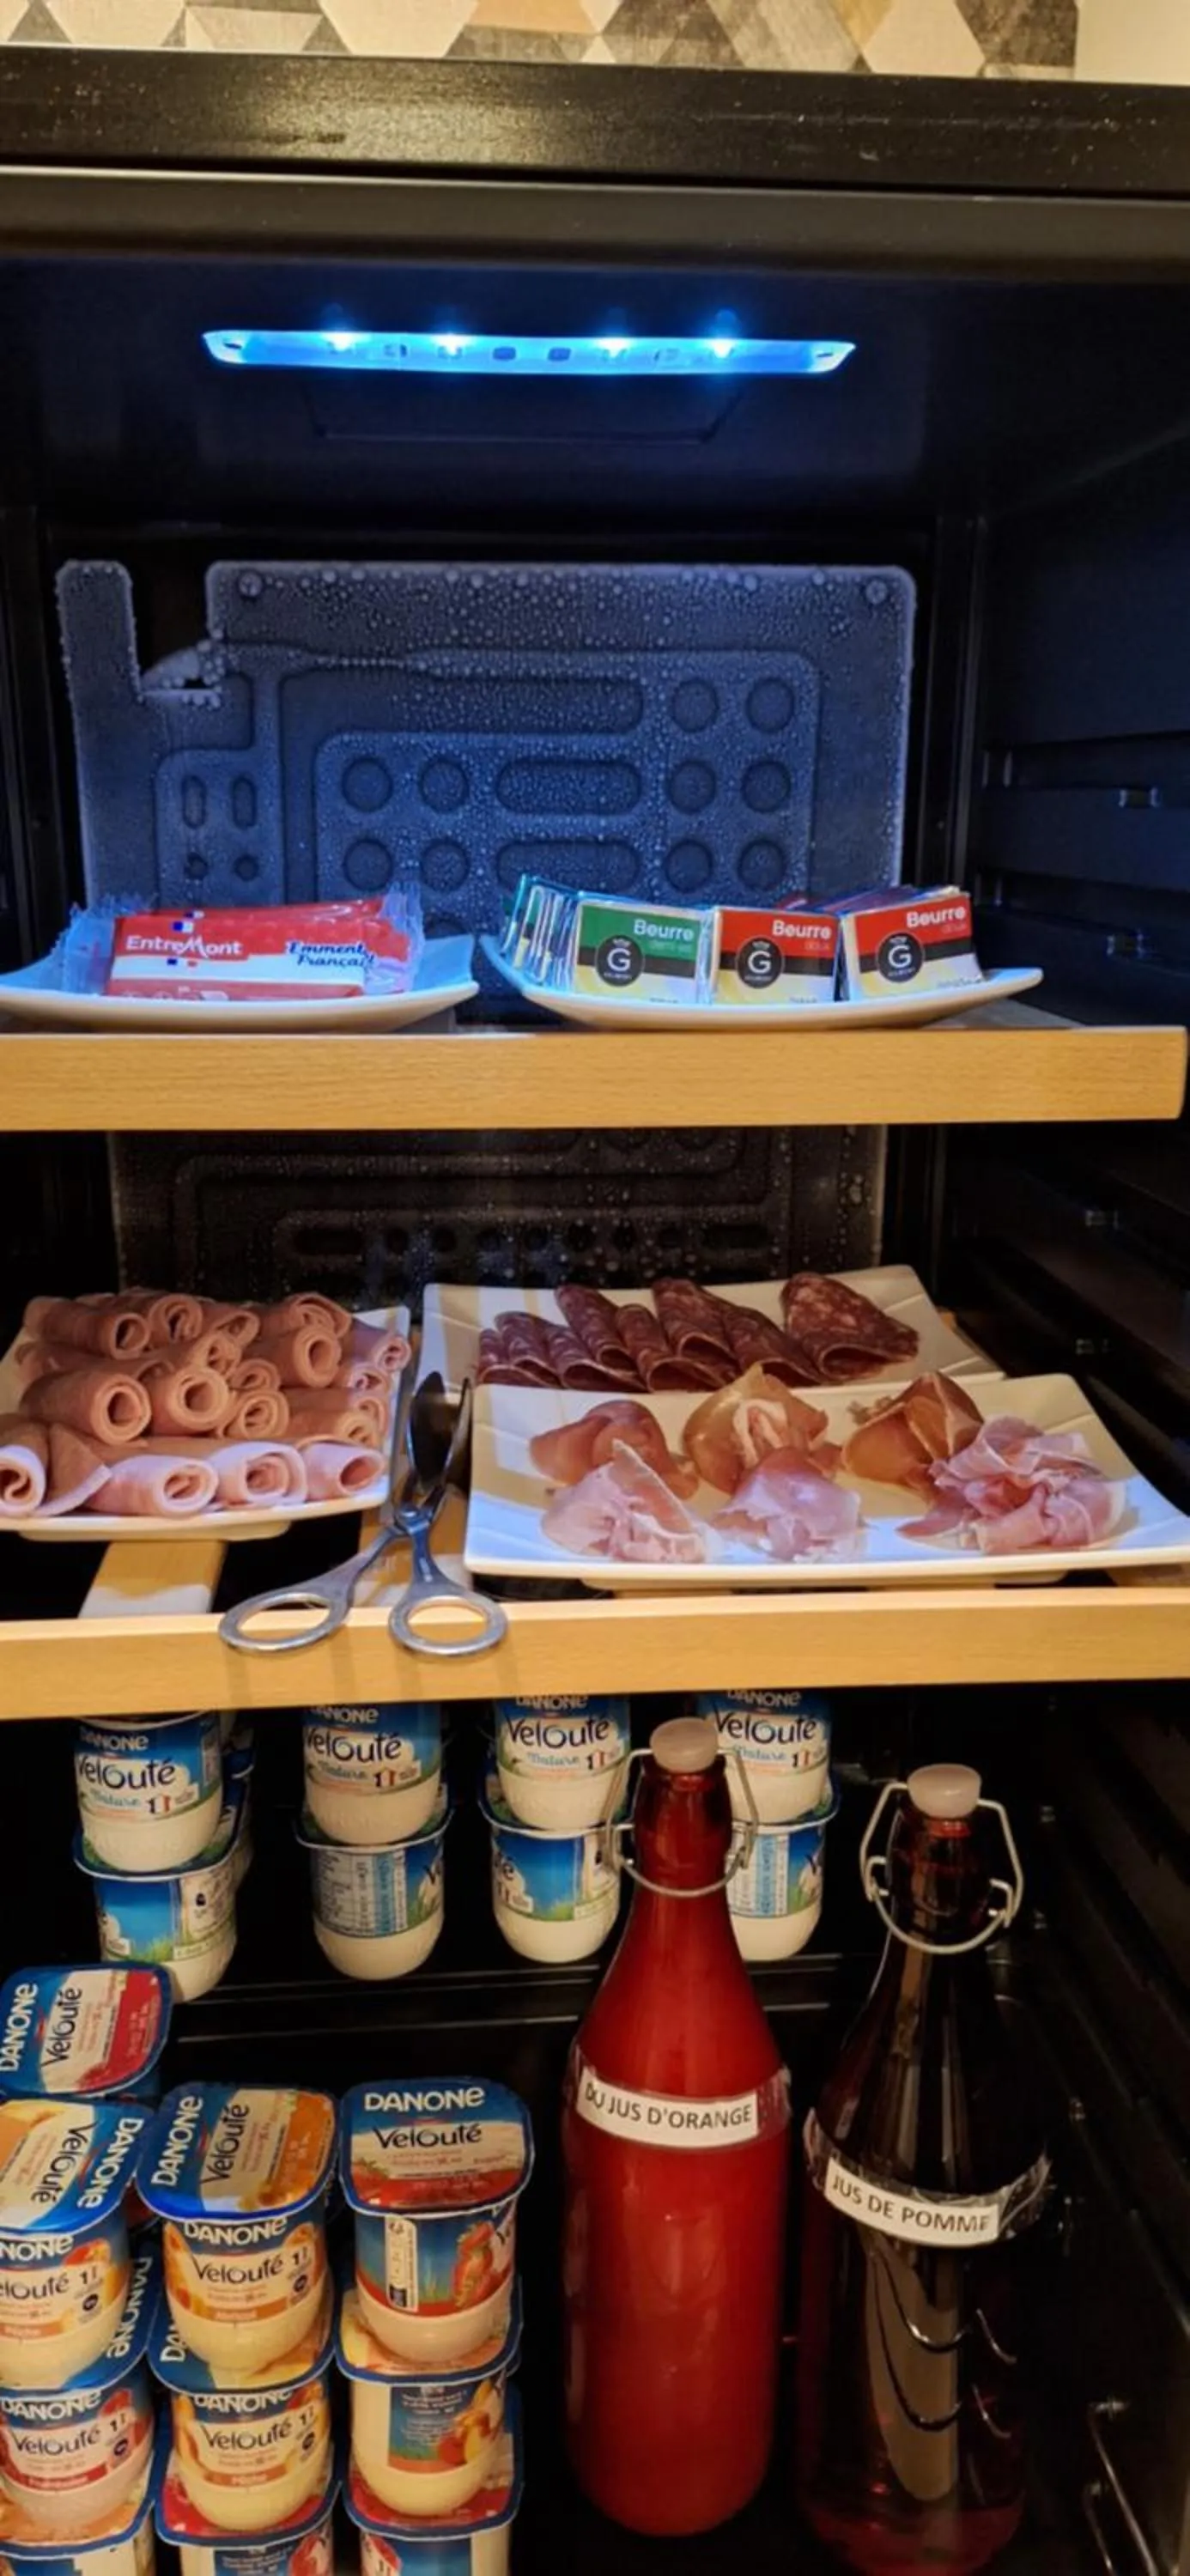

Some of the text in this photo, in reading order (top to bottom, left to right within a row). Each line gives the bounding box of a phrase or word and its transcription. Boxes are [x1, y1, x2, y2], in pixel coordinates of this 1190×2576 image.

[634, 918, 695, 941] Beurre
[773, 920, 832, 939] Beurre
[906, 906, 967, 928] Beurre
[607, 947, 631, 971] G
[748, 951, 771, 974] G
[888, 945, 912, 968] G
[0, 1983, 39, 2072] DANONE
[40, 1987, 82, 2068] Velouté
[364, 2087, 485, 2112] DANONE
[585, 2081, 752, 2129] DU JUS D'ORANGE
[151, 2095, 203, 2186] DANONE
[200, 2104, 250, 2184] Velouté
[373, 2123, 483, 2149] Velouté
[31, 2122, 97, 2204] Velouté
[77, 2117, 144, 2209] DANONE
[834, 2175, 862, 2205] JUS
[868, 2195, 895, 2219] DE
[184, 2217, 288, 2245] DANONE
[0, 2234, 74, 2262] NONE
[191, 2253, 283, 2284] Velouté
[0, 2275, 70, 2300] elouté
